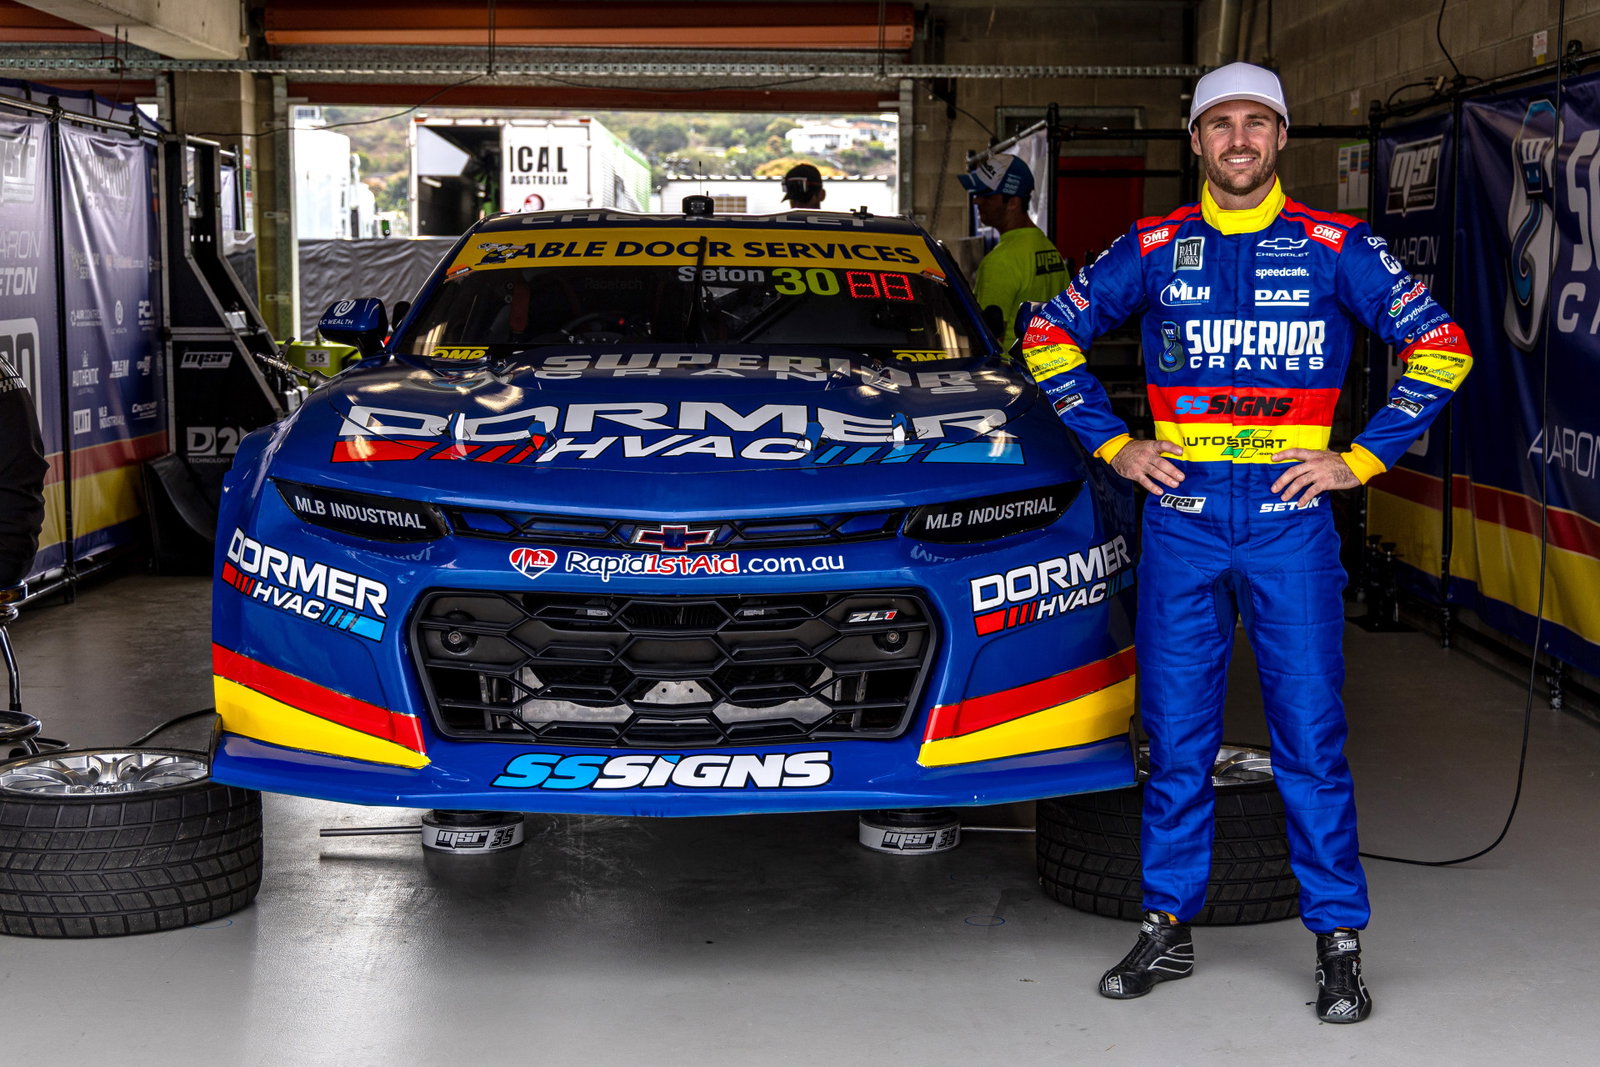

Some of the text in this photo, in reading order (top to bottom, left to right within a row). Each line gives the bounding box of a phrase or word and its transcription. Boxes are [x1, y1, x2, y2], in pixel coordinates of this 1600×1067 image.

[510, 175, 568, 185] AUSTRALIA
[1142, 229, 1169, 246] OMP
[1313, 225, 1342, 241] OMP
[514, 241, 920, 264] ABLE DOOR SERVICES
[677, 265, 840, 296] Seton 30
[1255, 267, 1310, 279] speedcafe.
[1169, 283, 1211, 301] MLH
[1254, 289, 1310, 301] DAF
[1185, 318, 1326, 356] SUPERIOR
[310, 353, 325, 363] 35
[1189, 355, 1325, 371] CRANES
[337, 401, 1021, 443] DORMER
[534, 435, 812, 463] HVAC
[1182, 435, 1287, 449] AUTOSPORT
[294, 496, 427, 529] MLB INDUSTRIAL
[925, 496, 1057, 530] MLB INDUSTRIAL
[227, 527, 388, 618] DORMER
[565, 550, 845, 582] Rapid1stAid.com.au
[970, 534, 1132, 612] DORMER
[253, 581, 326, 620] HVAC
[1036, 582, 1107, 620] HVAC
[848, 609, 898, 624] ZL1
